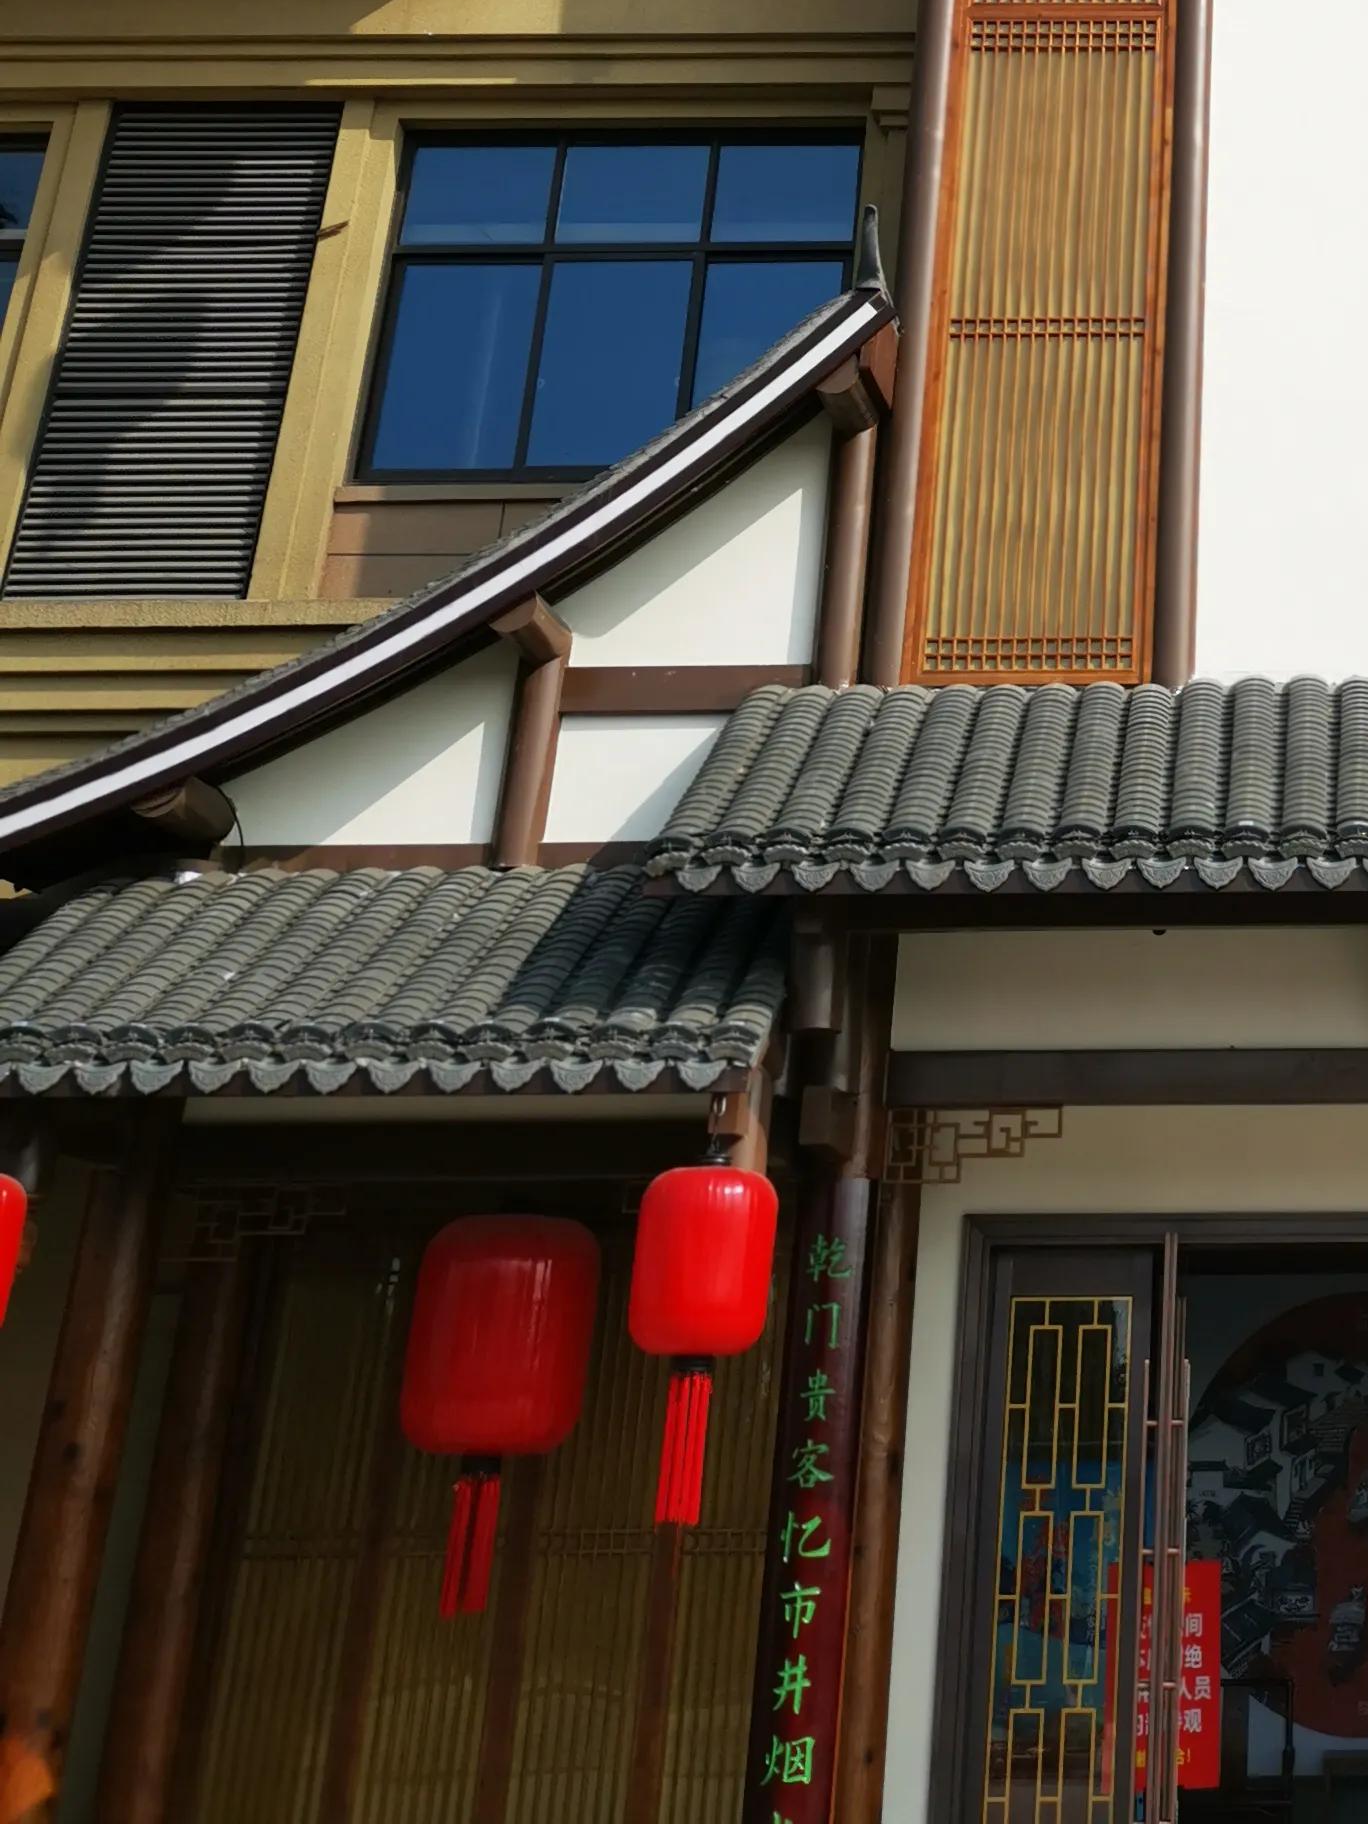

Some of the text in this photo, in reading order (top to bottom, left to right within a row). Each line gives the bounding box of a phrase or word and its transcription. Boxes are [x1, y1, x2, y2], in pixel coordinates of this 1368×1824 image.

[759, 1232, 854, 1824] 乾门贵客忆市井烟
